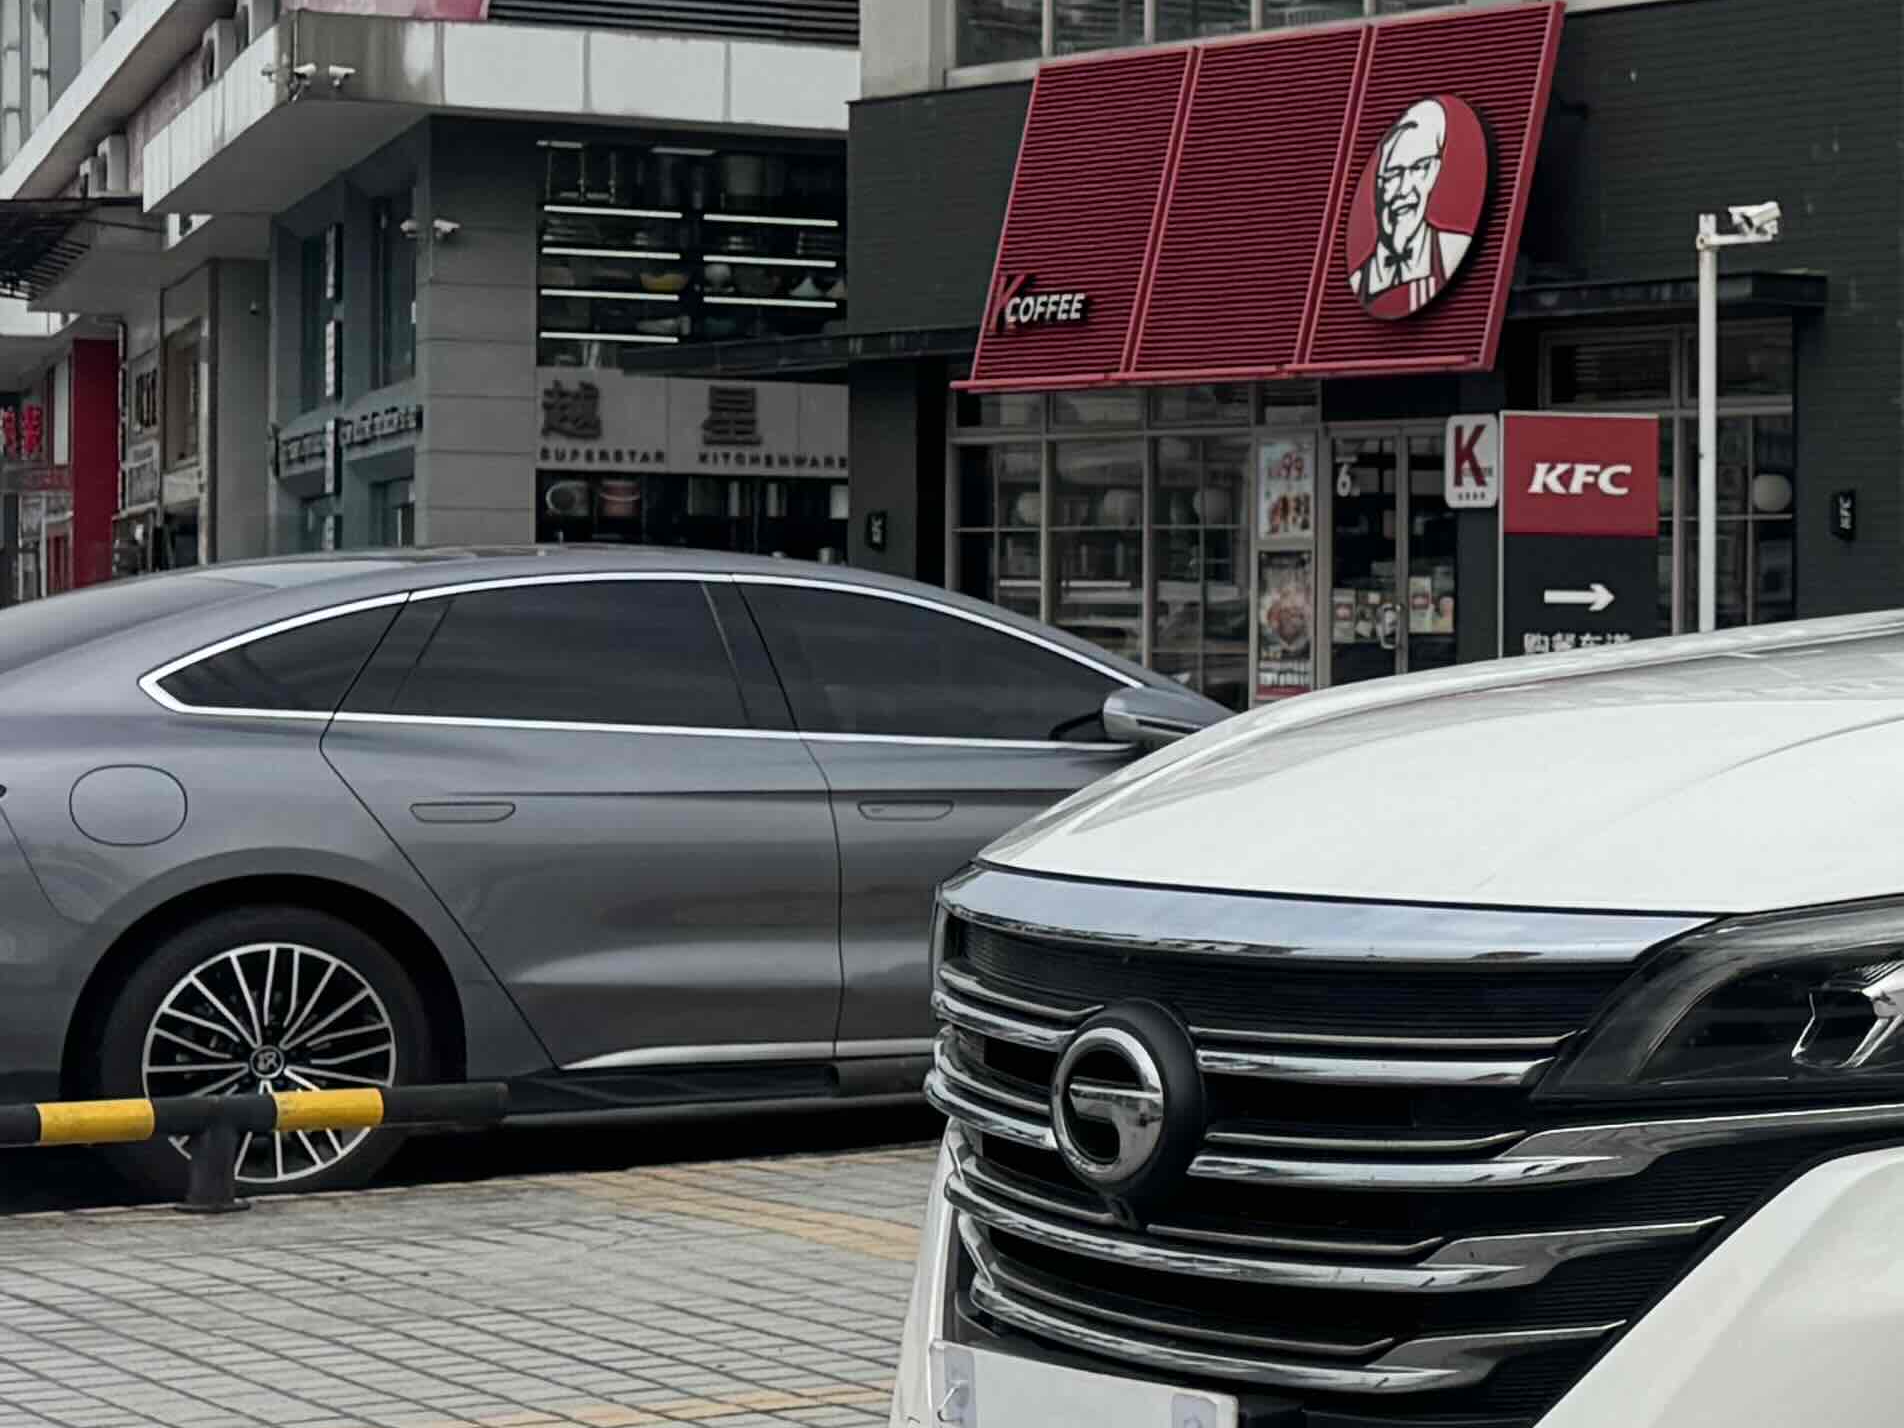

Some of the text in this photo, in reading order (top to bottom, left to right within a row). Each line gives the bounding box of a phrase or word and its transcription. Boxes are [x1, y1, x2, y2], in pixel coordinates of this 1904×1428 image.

[1005, 292, 1087, 324] COFFEE
[1454, 424, 1487, 488] K
[1527, 462, 1633, 495] KFC
